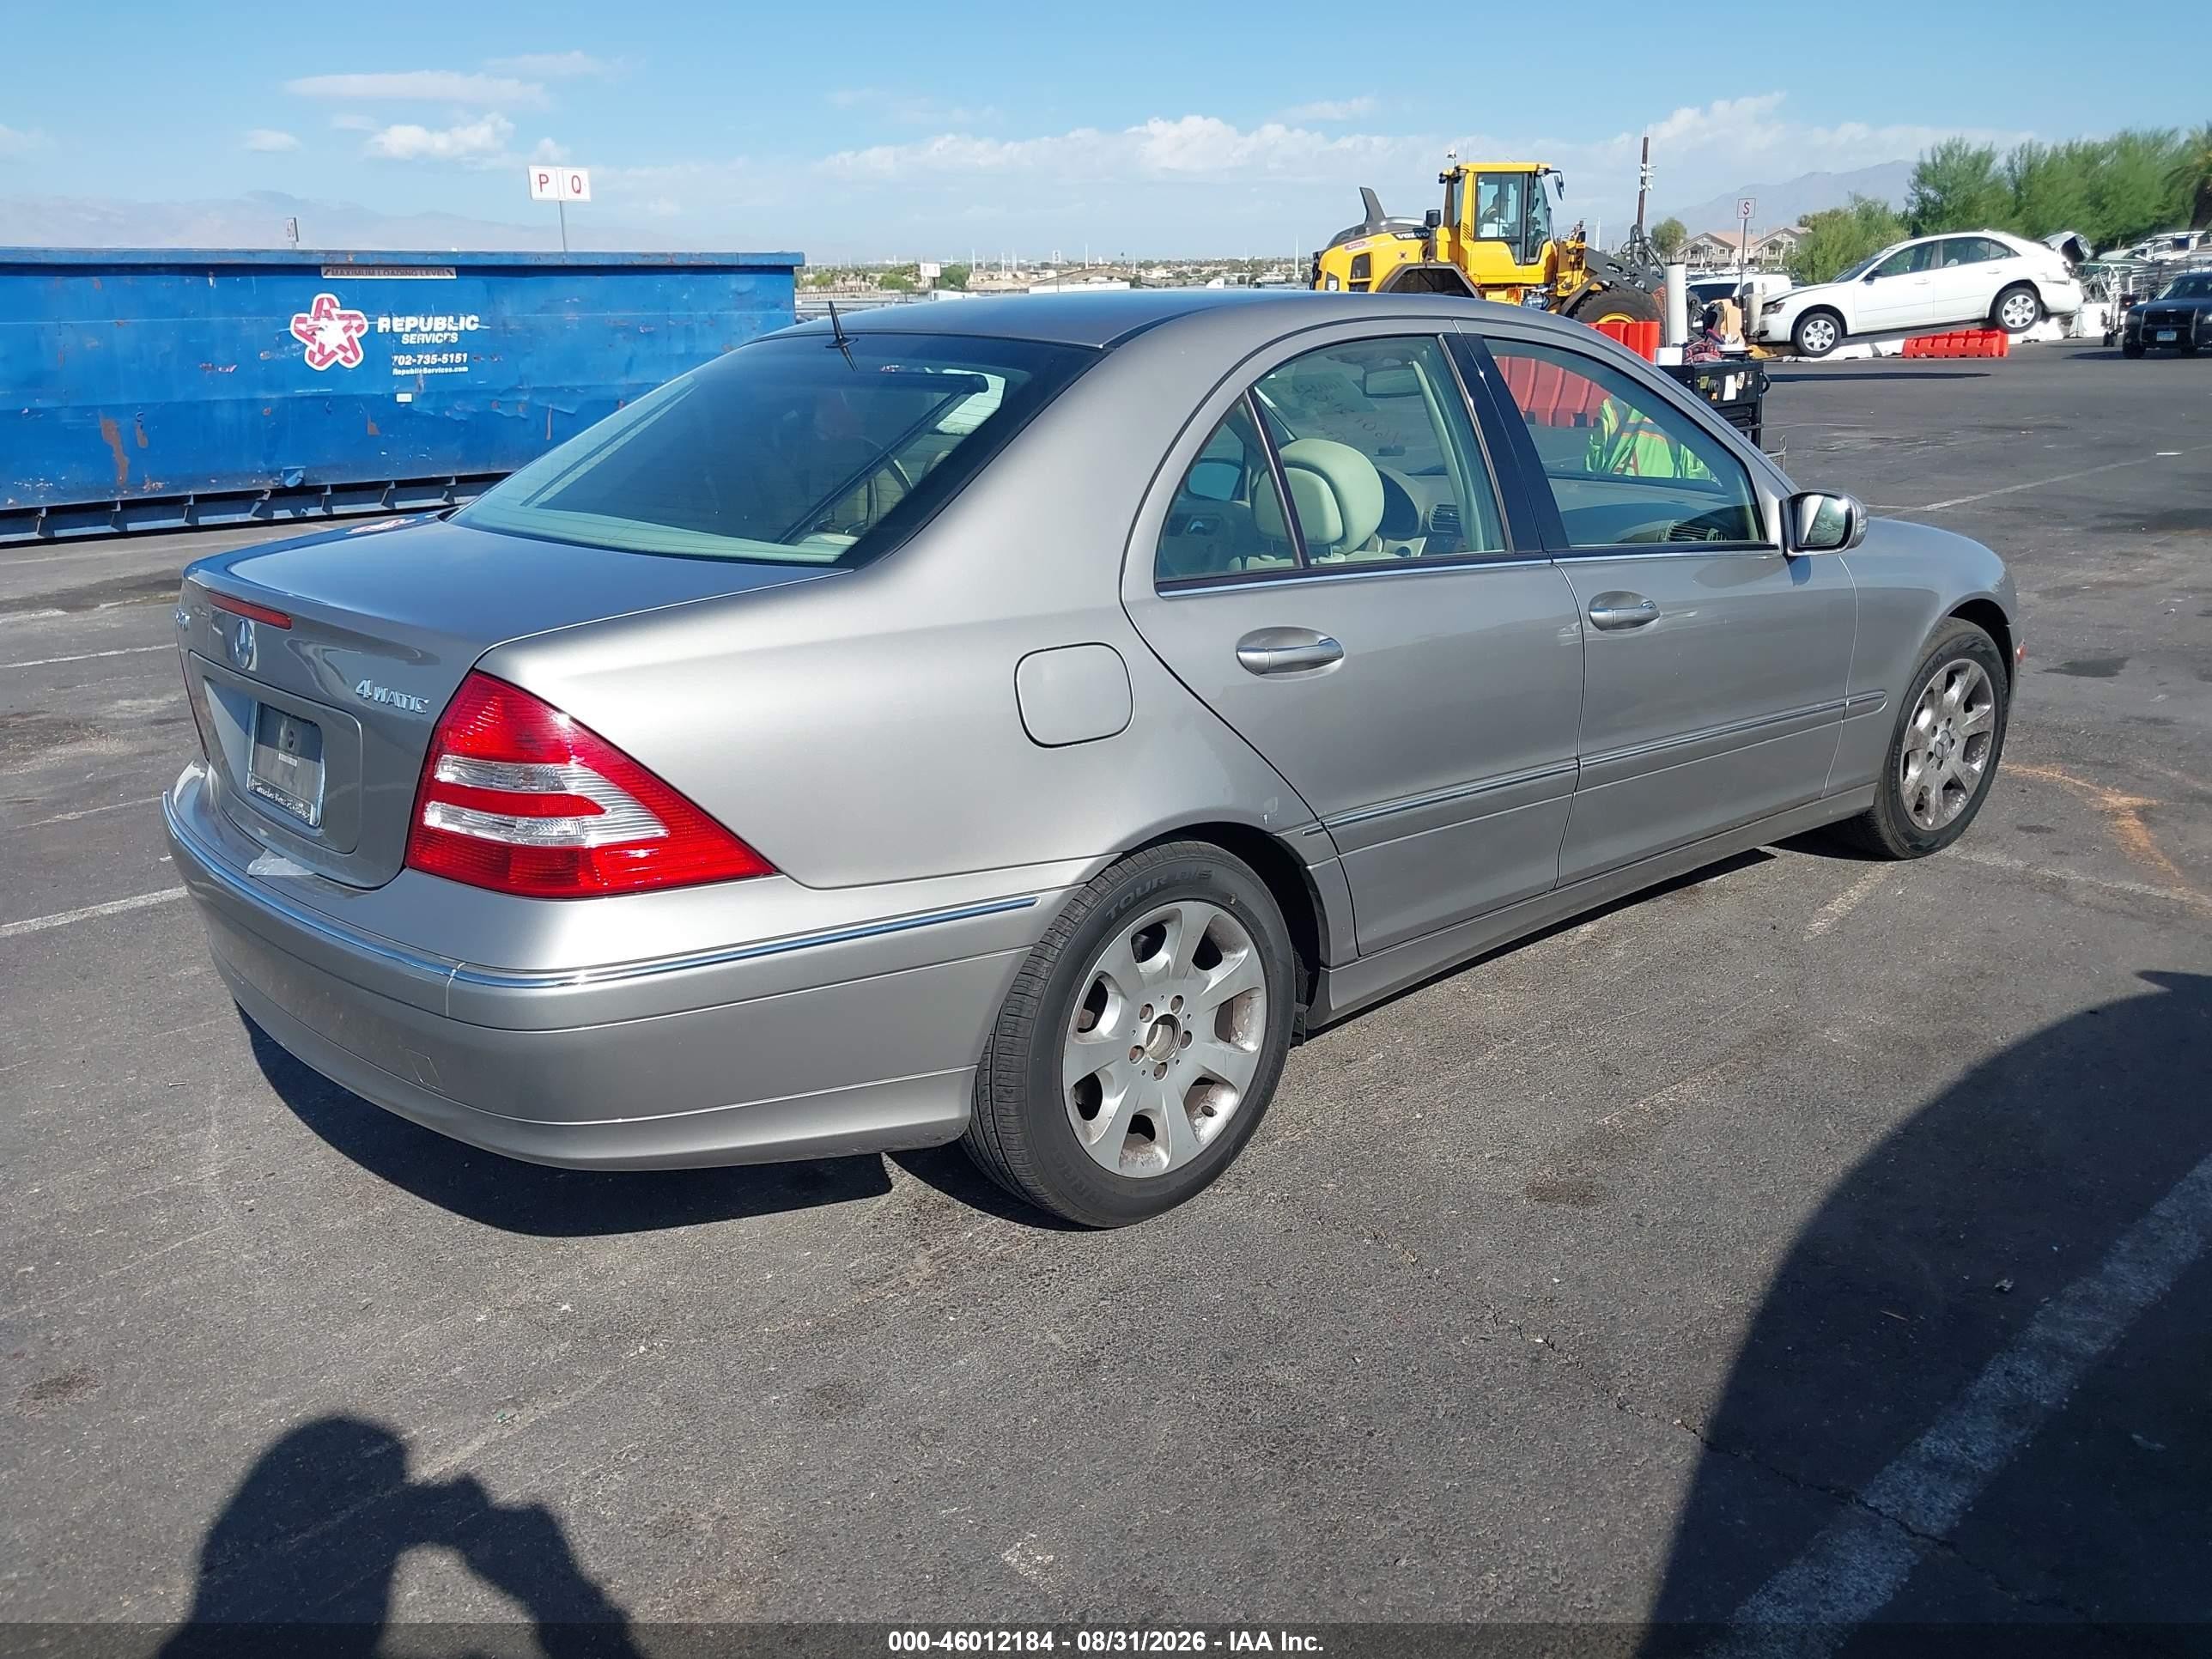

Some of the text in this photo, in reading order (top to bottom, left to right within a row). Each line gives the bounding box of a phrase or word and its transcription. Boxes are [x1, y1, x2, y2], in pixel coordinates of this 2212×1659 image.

[538, 173, 549, 192] P
[571, 174, 582, 194] Q
[1743, 201, 1751, 216] S
[377, 314, 479, 332] REPUBLIC
[401, 332, 459, 344] SERVICES
[392, 352, 468, 366] 702-735-5151
[392, 366, 469, 376] RepublicServices.com
[356, 679, 429, 714] 4MATIC
